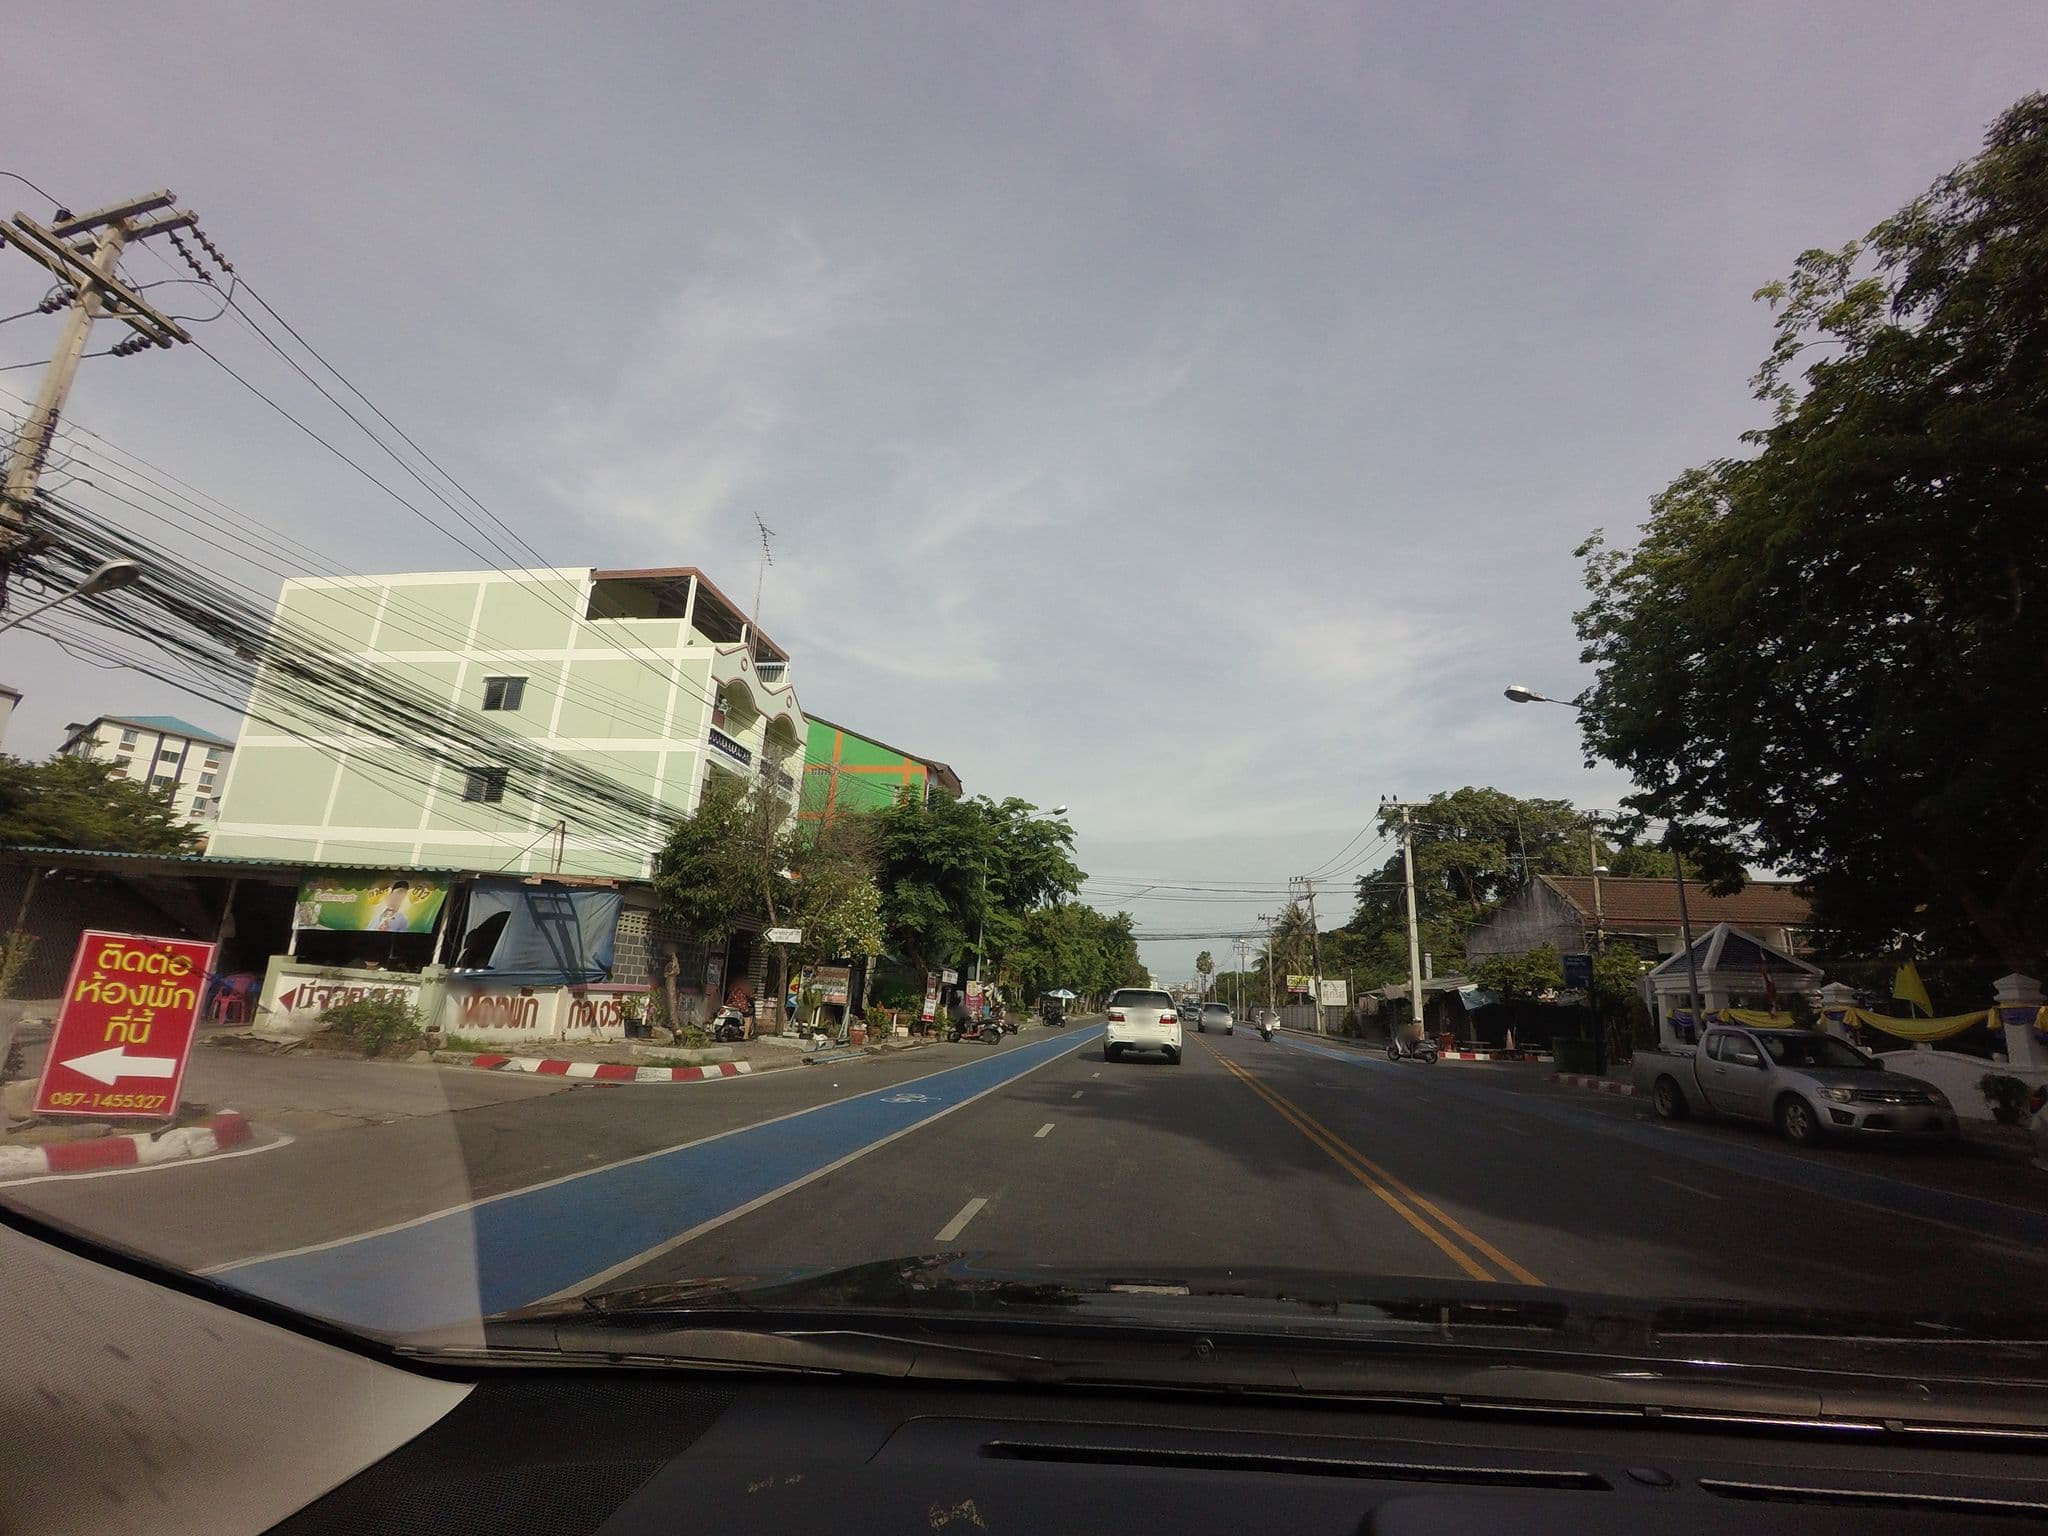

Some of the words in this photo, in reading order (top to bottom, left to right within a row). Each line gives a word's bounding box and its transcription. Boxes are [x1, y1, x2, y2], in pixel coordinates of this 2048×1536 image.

[98, 943, 193, 977] ติดต่อ
[74, 971, 196, 1010] ห้องพัก
[49, 1091, 167, 1109] 087-1455327
